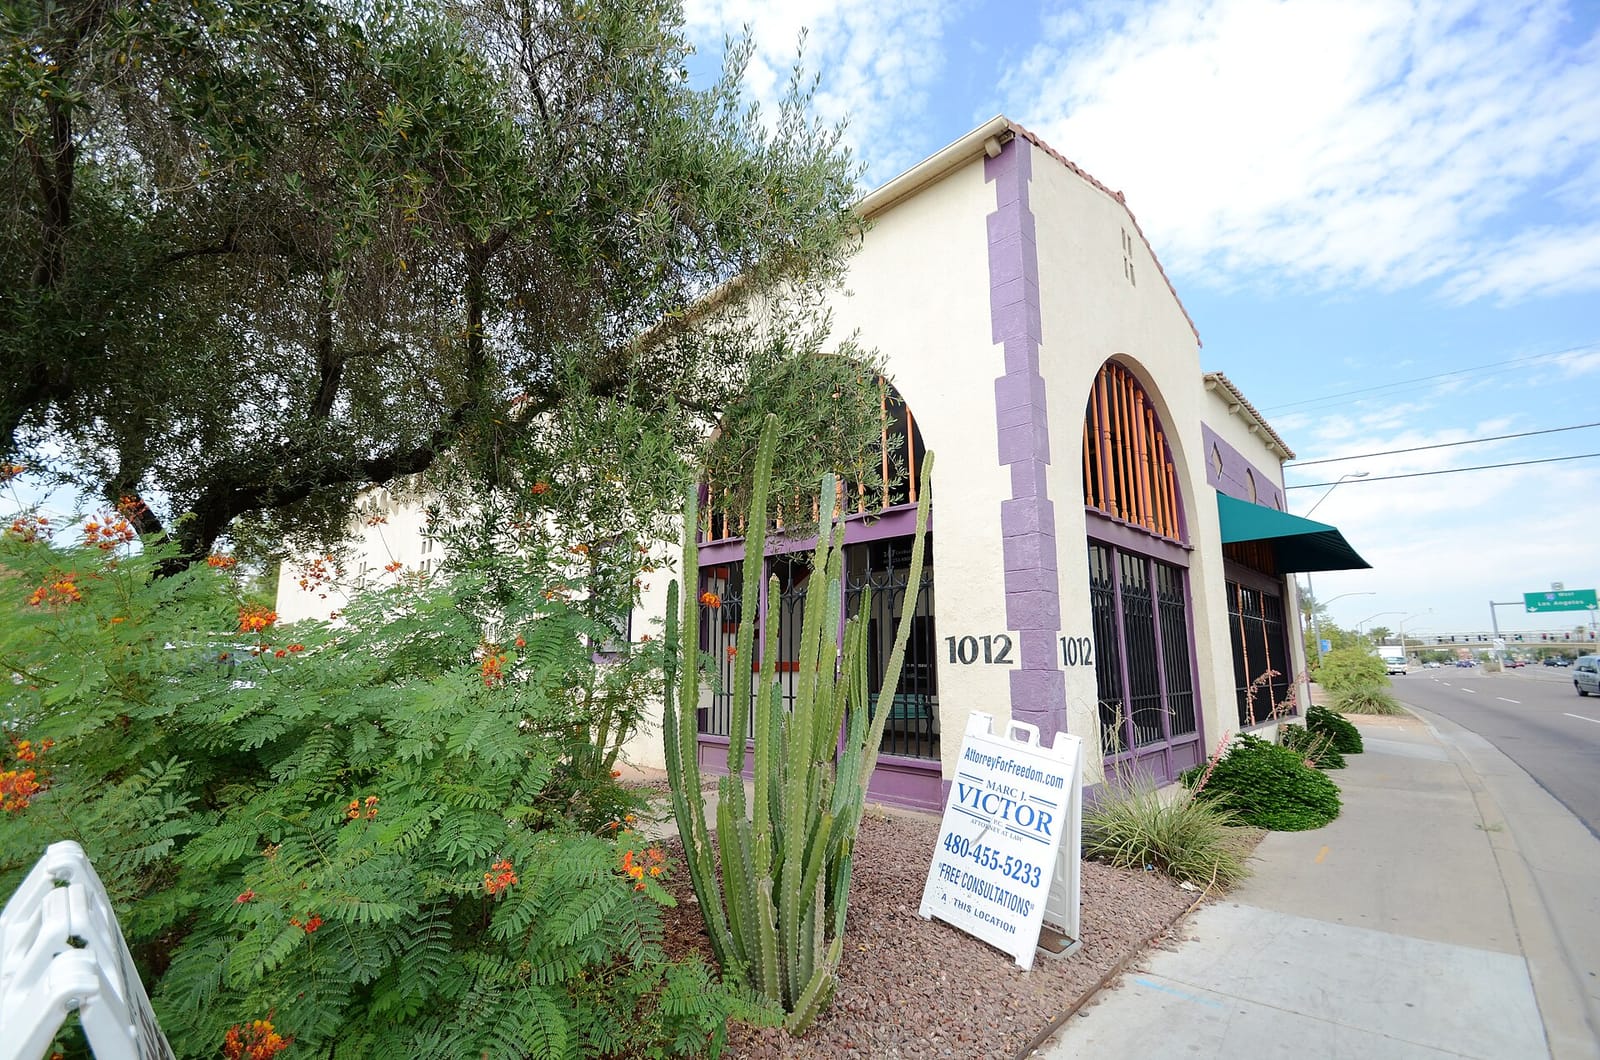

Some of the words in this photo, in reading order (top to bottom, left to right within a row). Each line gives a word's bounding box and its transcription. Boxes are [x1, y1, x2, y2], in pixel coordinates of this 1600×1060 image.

[945, 634, 1013, 664] 1012
[1060, 637, 1093, 666] 1012
[986, 780, 1018, 798] MARC
[1020, 791, 1027, 801] J.
[958, 782, 1052, 836] VICTOR
[944, 832, 1041, 888] 480-455-5233
[953, 898, 972, 913] THIS
[974, 908, 1016, 934] LOCATION
